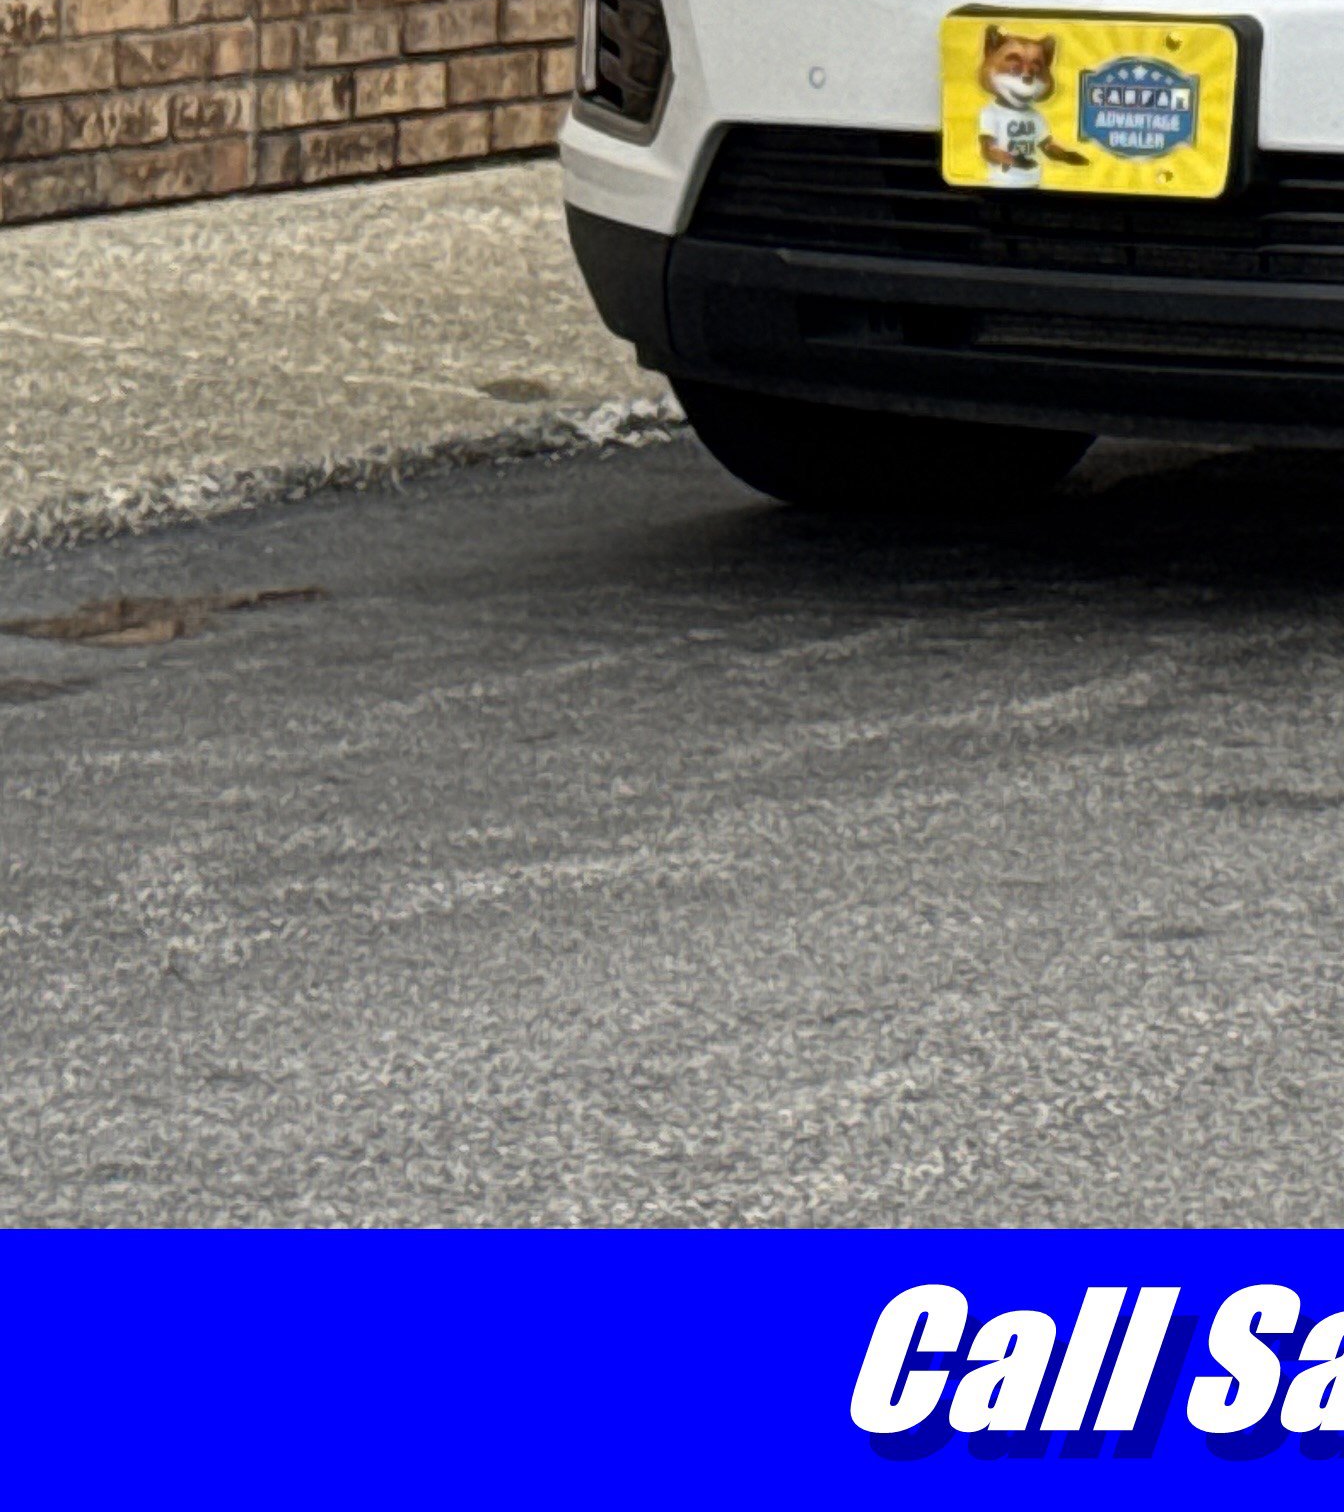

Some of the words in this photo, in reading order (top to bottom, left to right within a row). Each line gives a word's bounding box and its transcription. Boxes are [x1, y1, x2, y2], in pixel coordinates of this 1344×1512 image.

[1090, 87, 1191, 112] CARFAX
[1094, 110, 1180, 133] ADVANTAGE
[1107, 131, 1165, 149] DEALER
